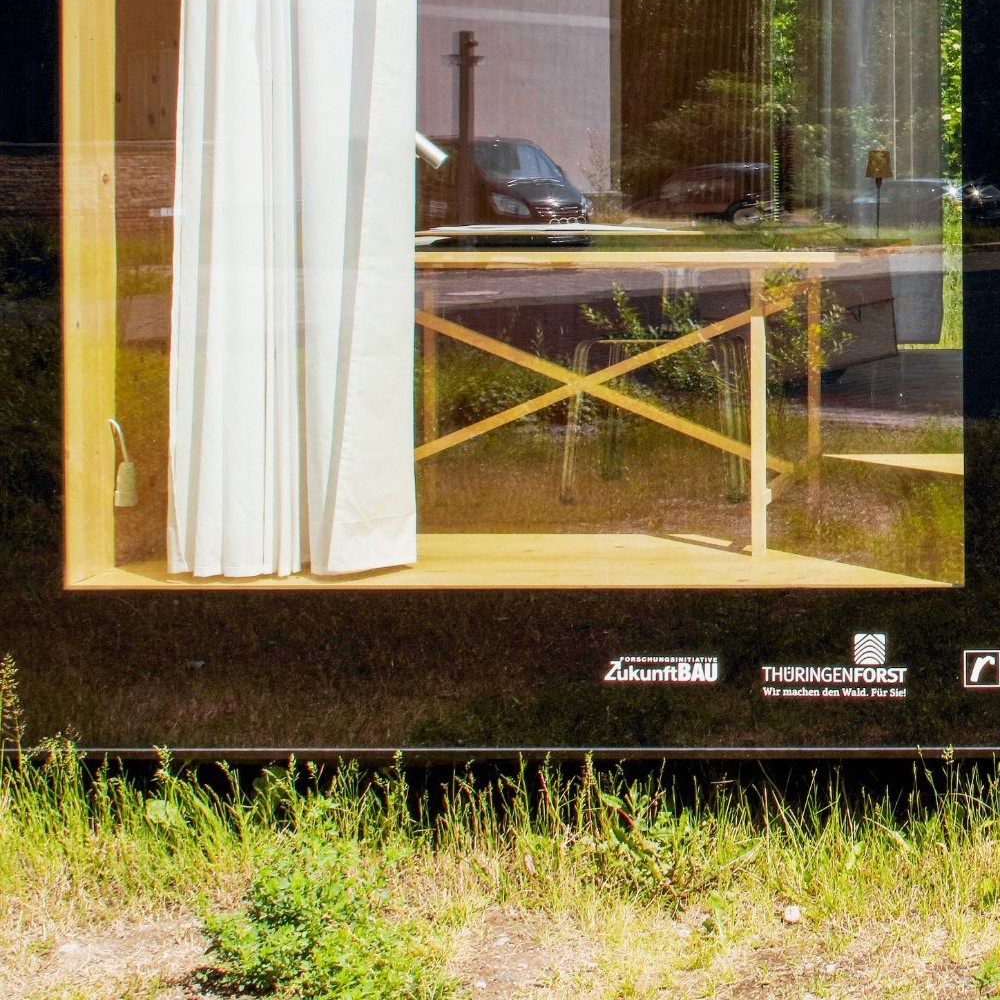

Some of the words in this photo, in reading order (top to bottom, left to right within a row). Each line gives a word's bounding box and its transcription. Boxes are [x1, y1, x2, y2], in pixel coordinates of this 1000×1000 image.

[604, 660, 719, 682] ZukunftBAU
[761, 666, 907, 683] THÜRINGENFORST
[763, 687, 781, 697] Wir
[782, 687, 820, 697] machen
[822, 688, 840, 697] den
[842, 688, 869, 697] Wald.
[871, 688, 887, 697] Für
[889, 688, 907, 698] Sie!
